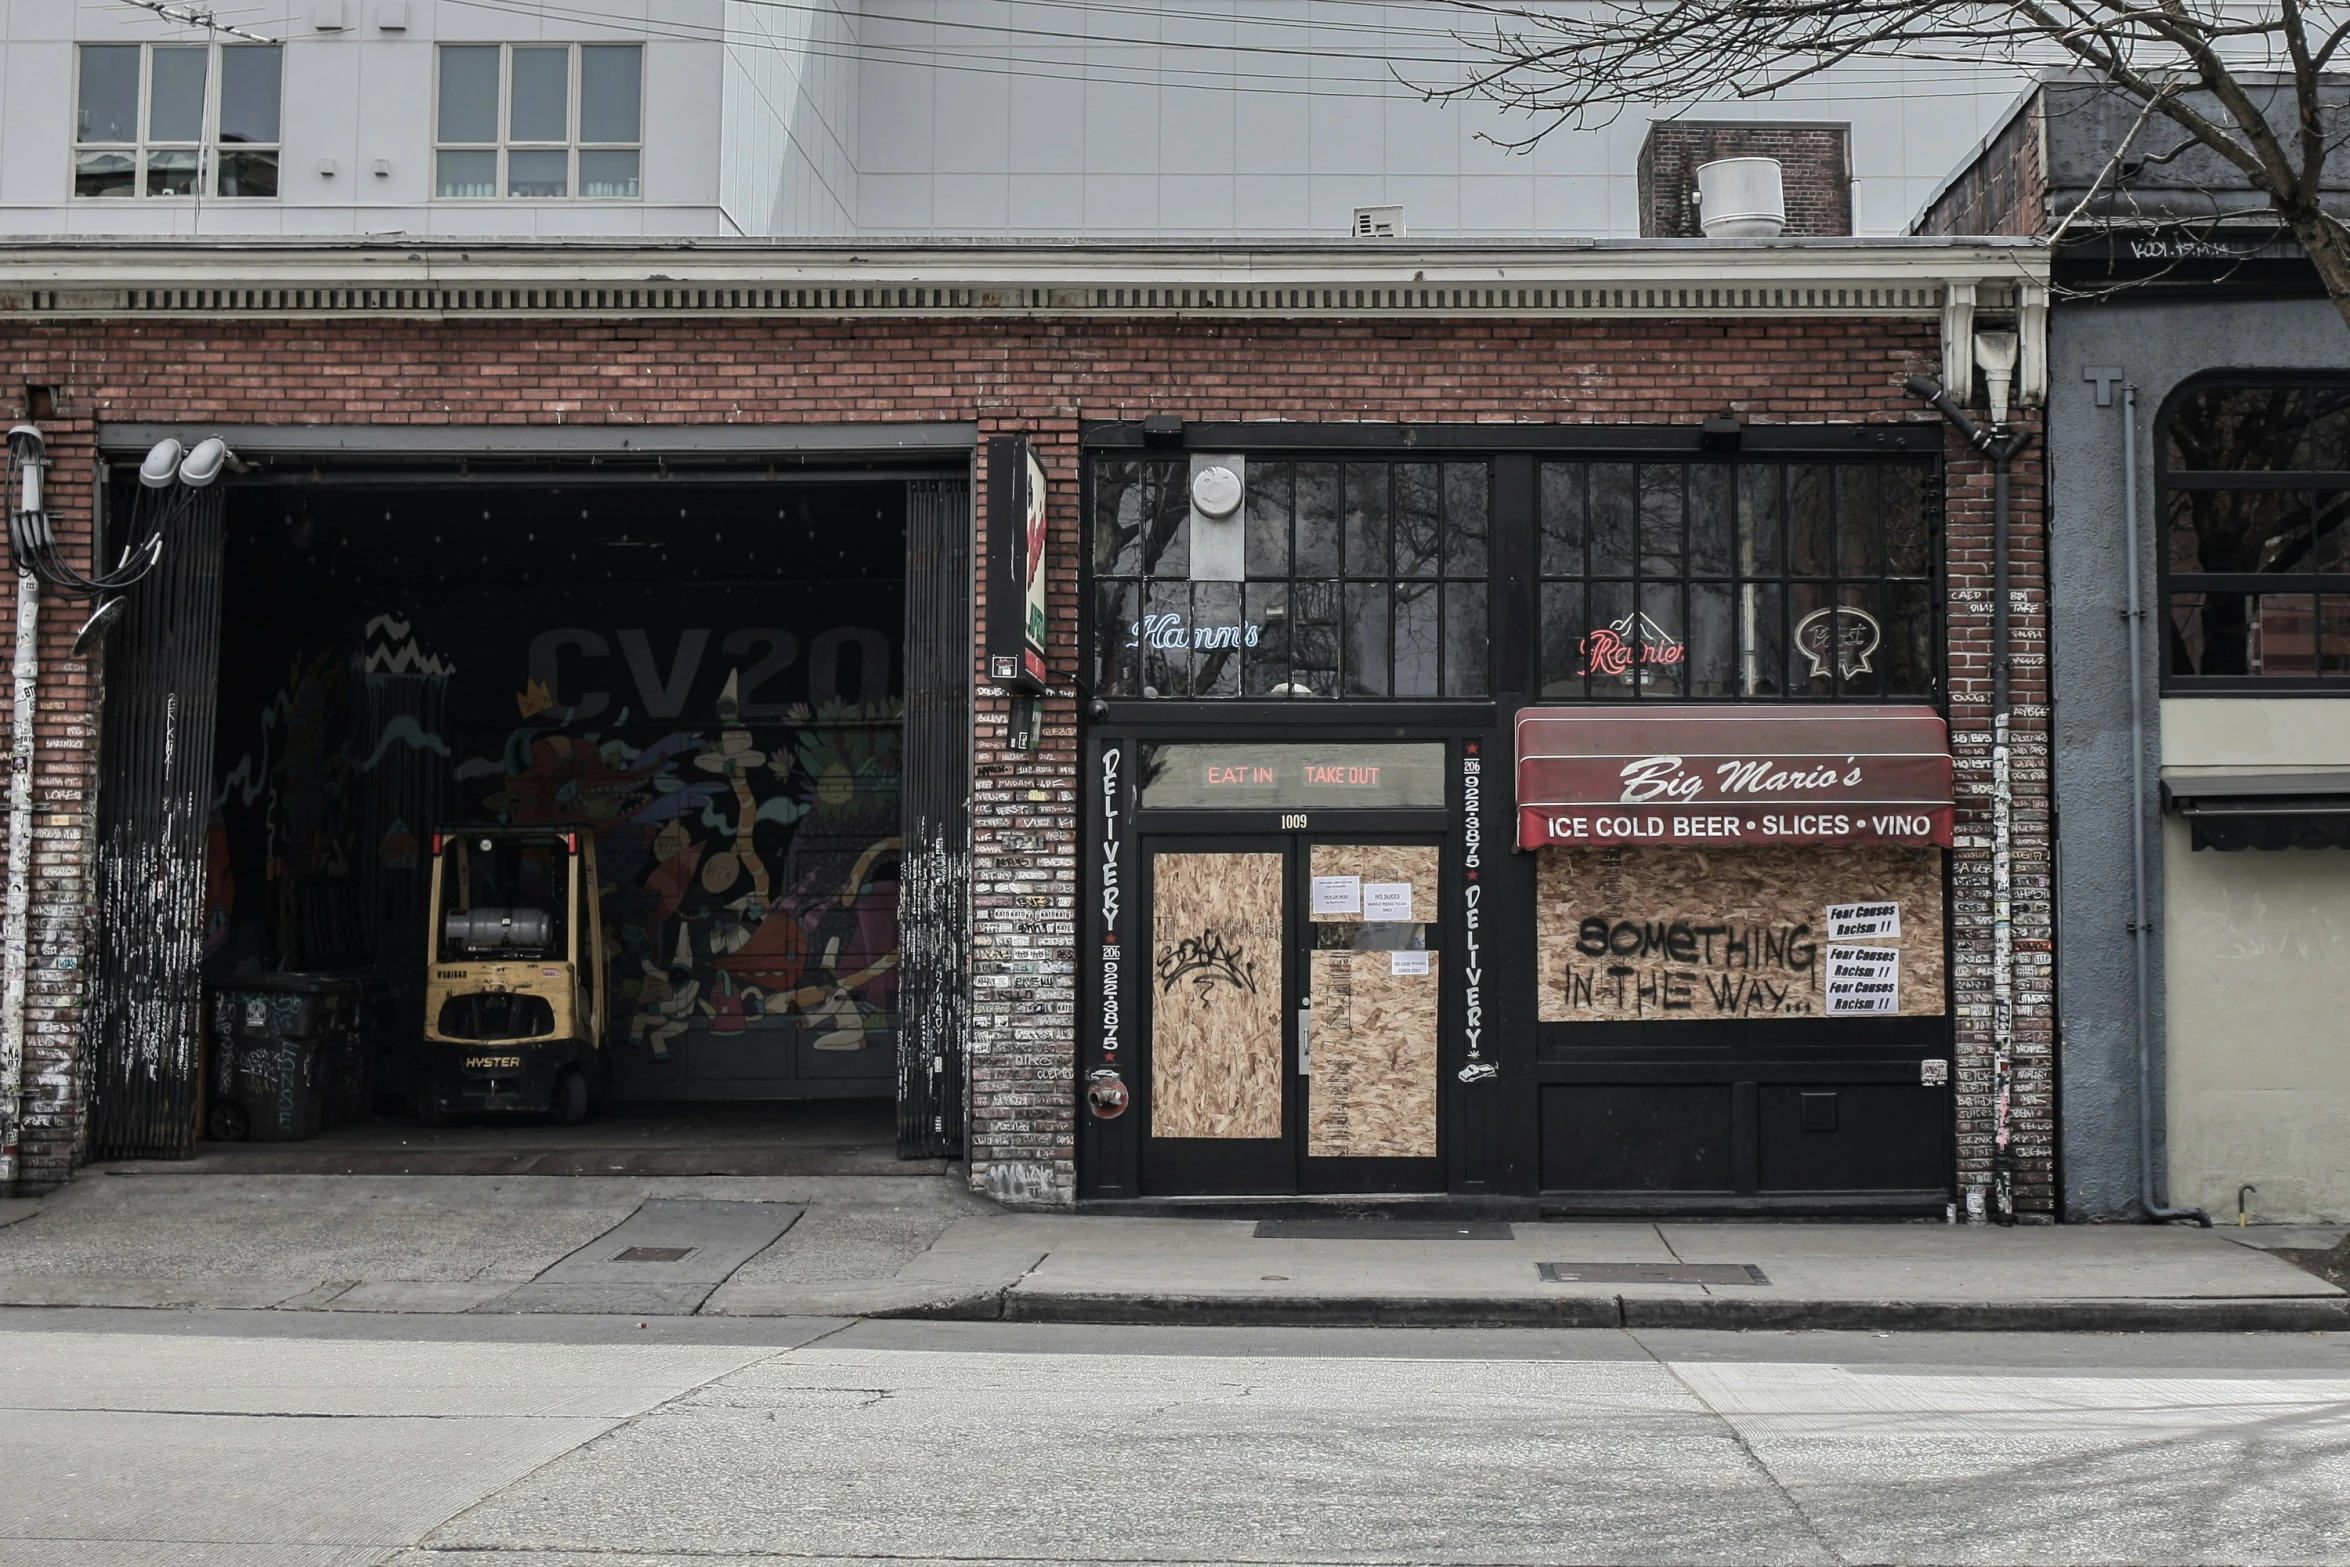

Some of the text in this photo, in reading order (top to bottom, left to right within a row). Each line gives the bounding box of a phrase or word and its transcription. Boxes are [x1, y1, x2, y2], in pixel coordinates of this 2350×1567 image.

[1464, 760, 1480, 772] 206
[1208, 766, 1273, 784] EAT IN
[1304, 766, 1380, 784] TAKE OUT
[1620, 755, 1864, 803] Big Mario's
[1281, 814, 1308, 830] 1009
[1548, 814, 1931, 838] ICE COLD BEER SLICES VINO
[1102, 748, 1120, 932] DELIVERY
[1830, 905, 1896, 920] Fear Causes
[1836, 920, 1891, 936] Racism !!
[1102, 946, 1120, 958] 206
[1830, 948, 1896, 962] Fear Causes
[1464, 885, 1482, 1048] DELIVERY
[1834, 965, 1890, 978] Racism !!
[1566, 964, 1594, 1009] IN
[1607, 965, 1698, 1017] THE
[1829, 982, 1894, 993] Fear Causes
[1834, 998, 1890, 1010] Racism !!
[466, 1057, 520, 1068] HYSTER
